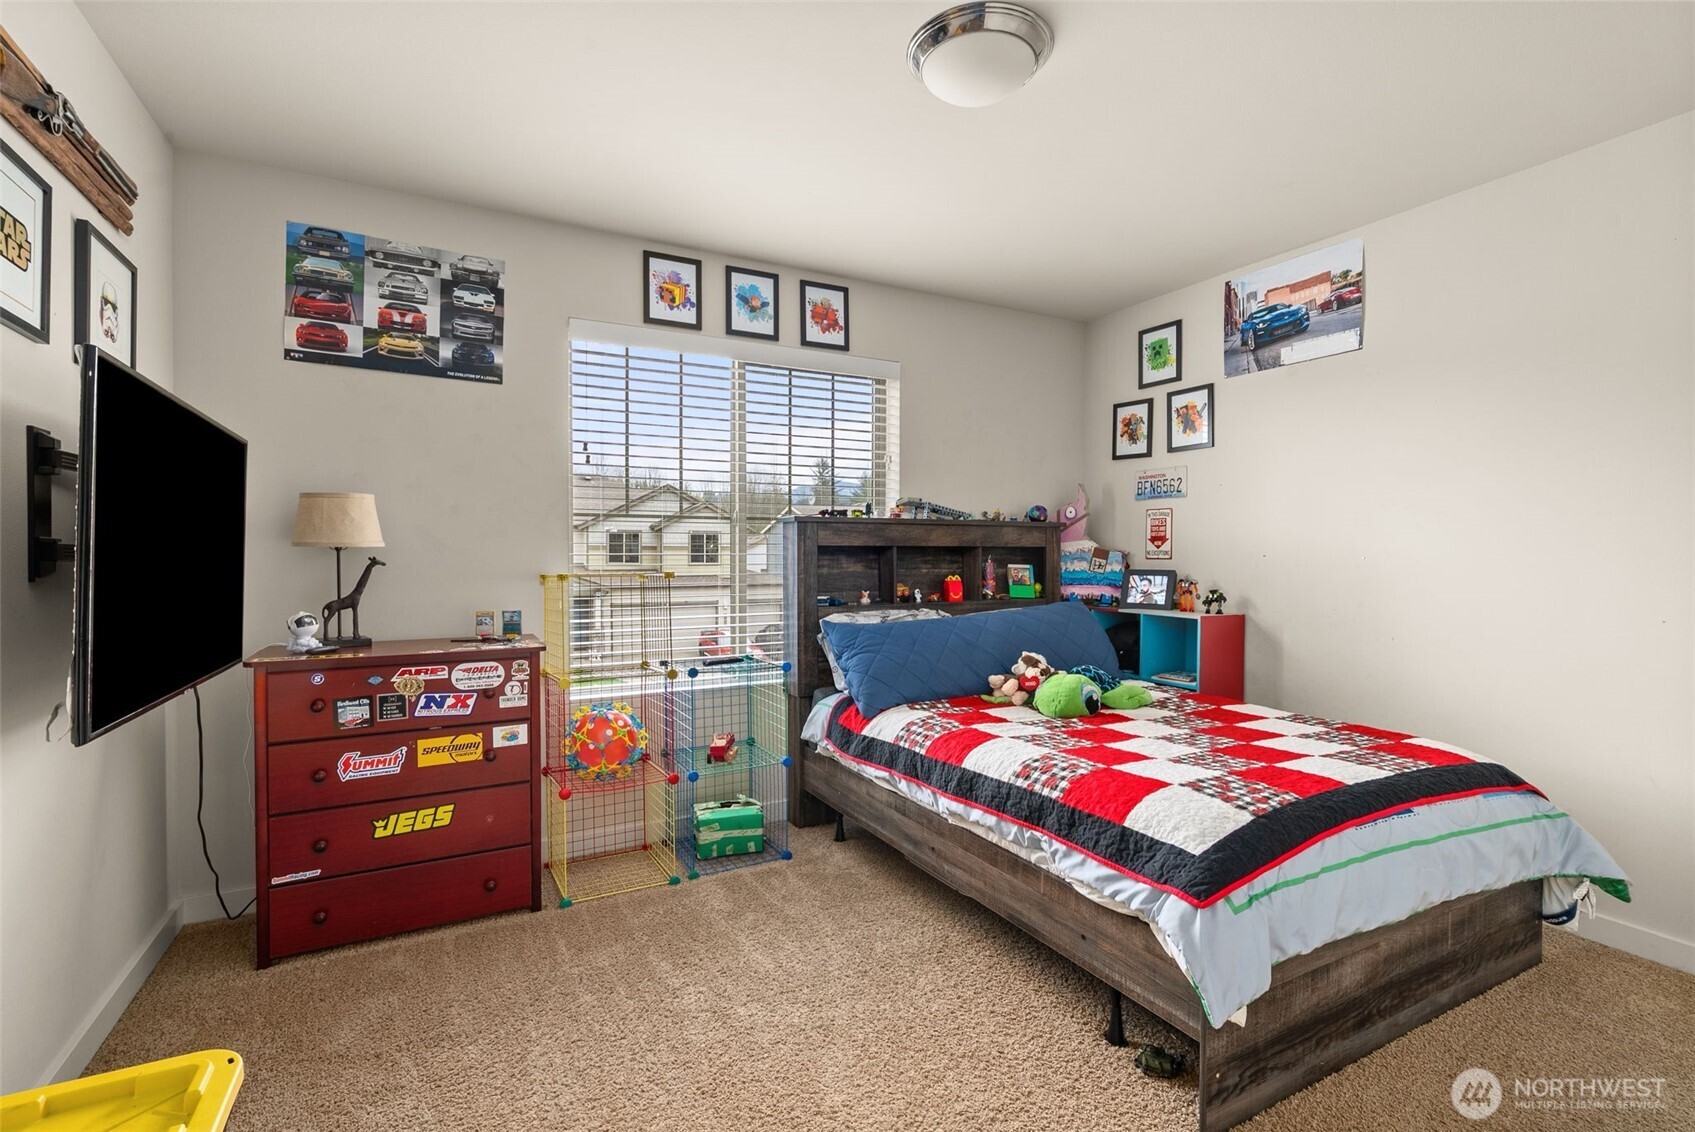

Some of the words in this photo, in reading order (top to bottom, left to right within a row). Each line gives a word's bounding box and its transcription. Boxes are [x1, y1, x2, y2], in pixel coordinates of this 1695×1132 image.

[1136, 477, 1183, 496] BFN6562
[397, 667, 447, 677] ARP
[472, 665, 500, 673] DELTA
[419, 694, 474, 710] NX
[421, 741, 481, 756] SPEEDWAY
[373, 803, 456, 839] JEGS
